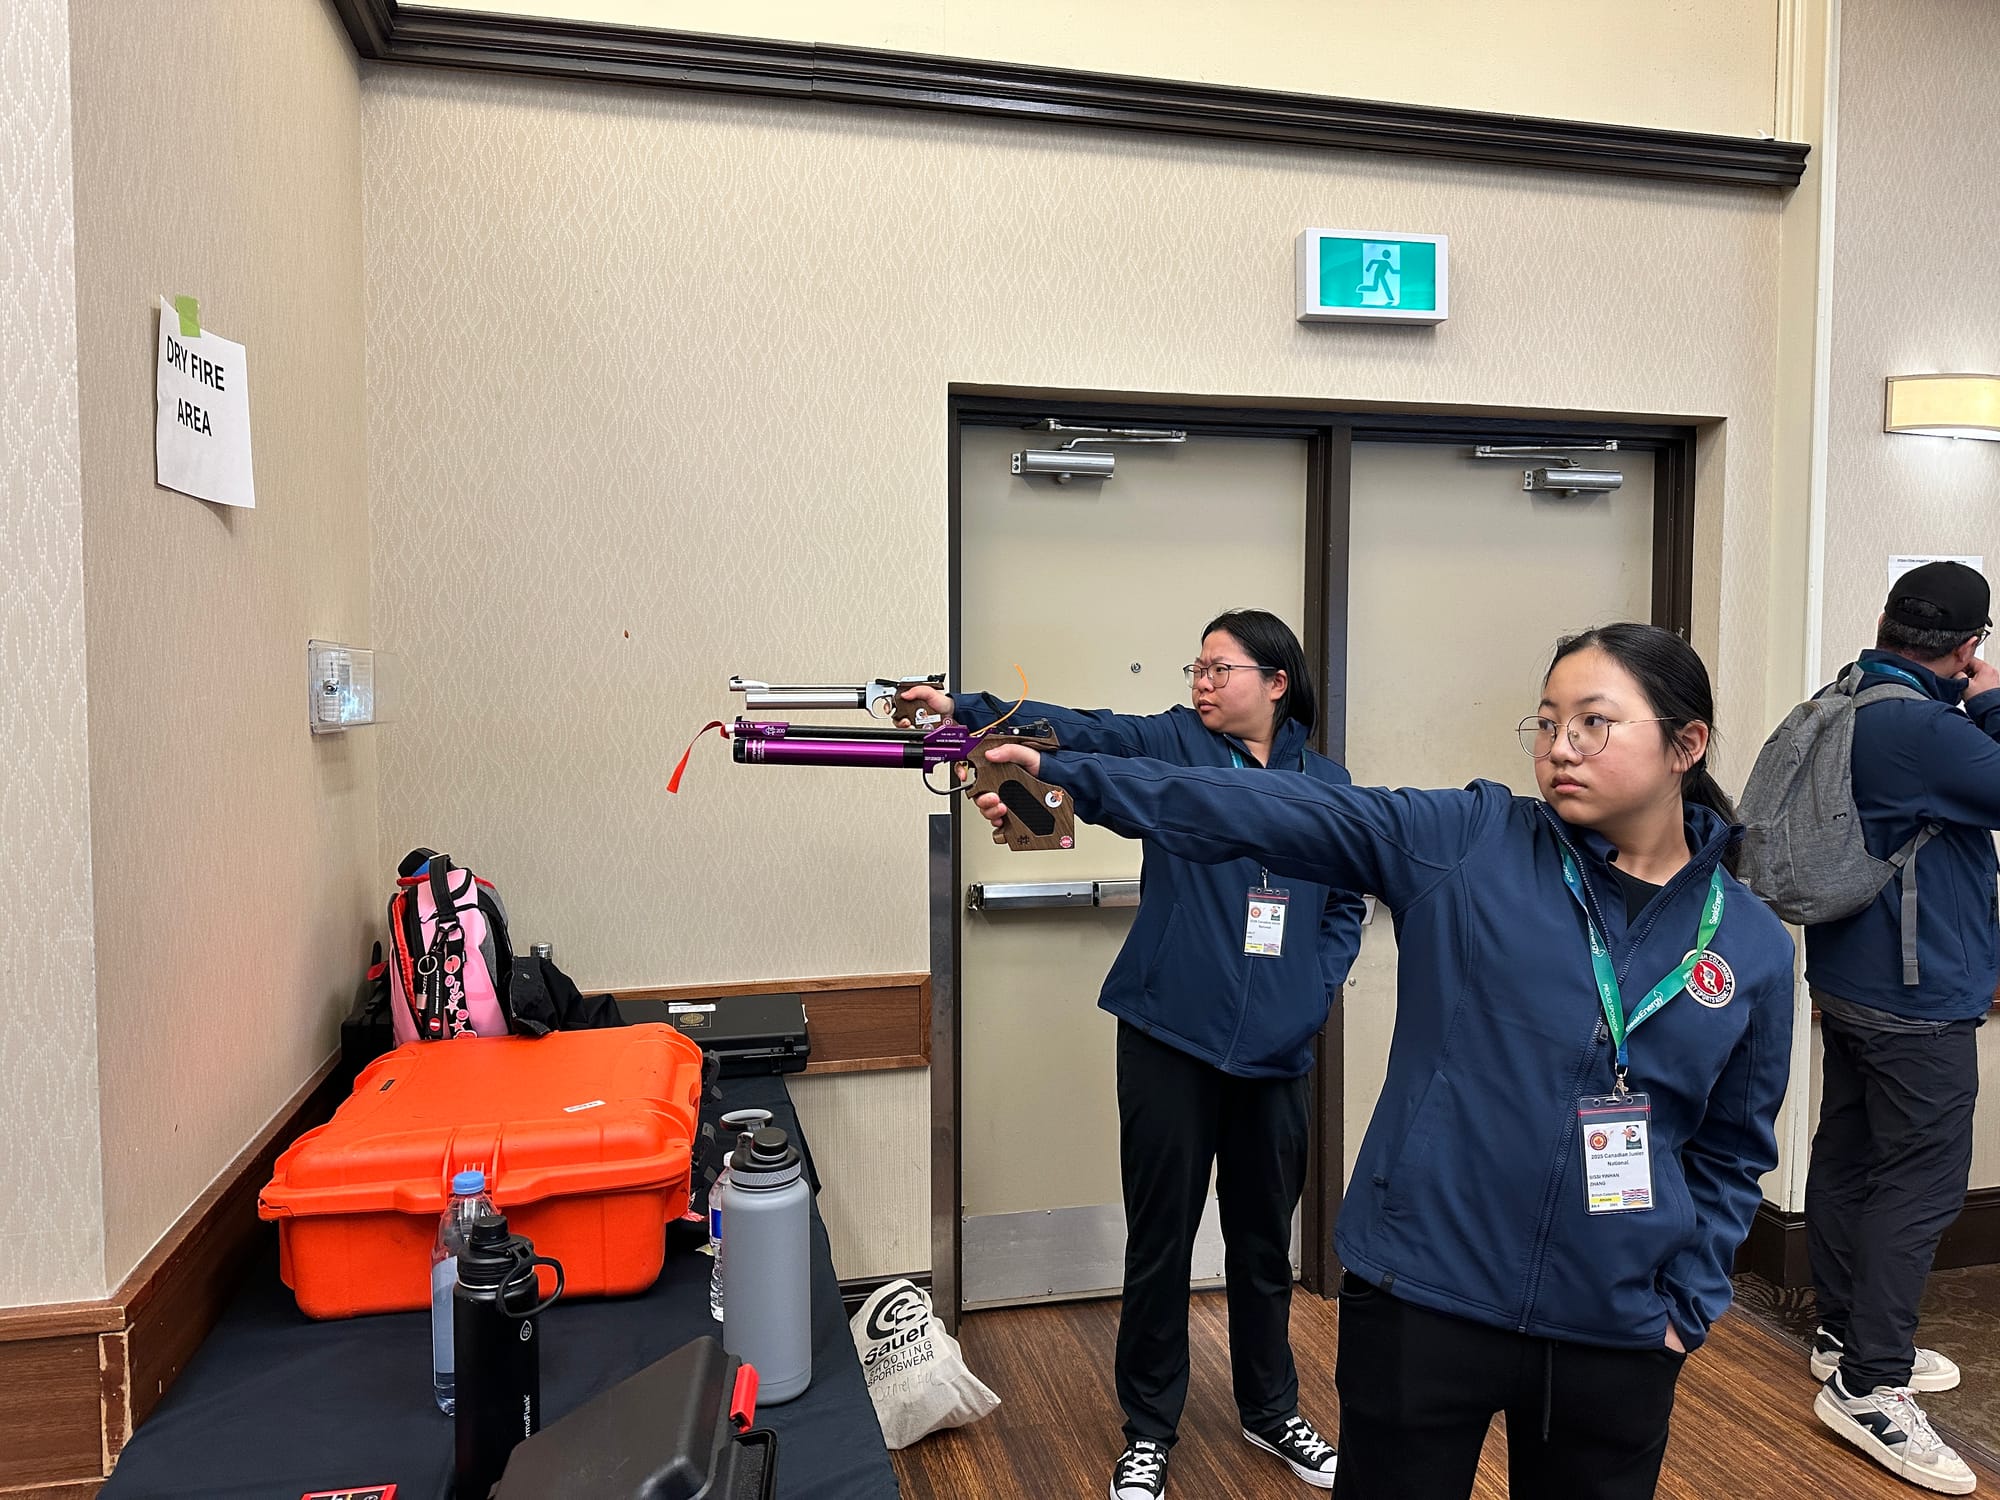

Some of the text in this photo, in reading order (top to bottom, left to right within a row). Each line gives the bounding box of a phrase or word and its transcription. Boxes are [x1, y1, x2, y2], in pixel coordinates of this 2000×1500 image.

[167, 335, 225, 391] DRY FIRE
[177, 397, 212, 436] AREA
[1602, 983, 1619, 1032] PROUD SPONSOR
[867, 1350, 934, 1388] SPORTSWEAR
[869, 1340, 932, 1377] SHOOTING
[523, 1394, 532, 1438] rmoFlask
